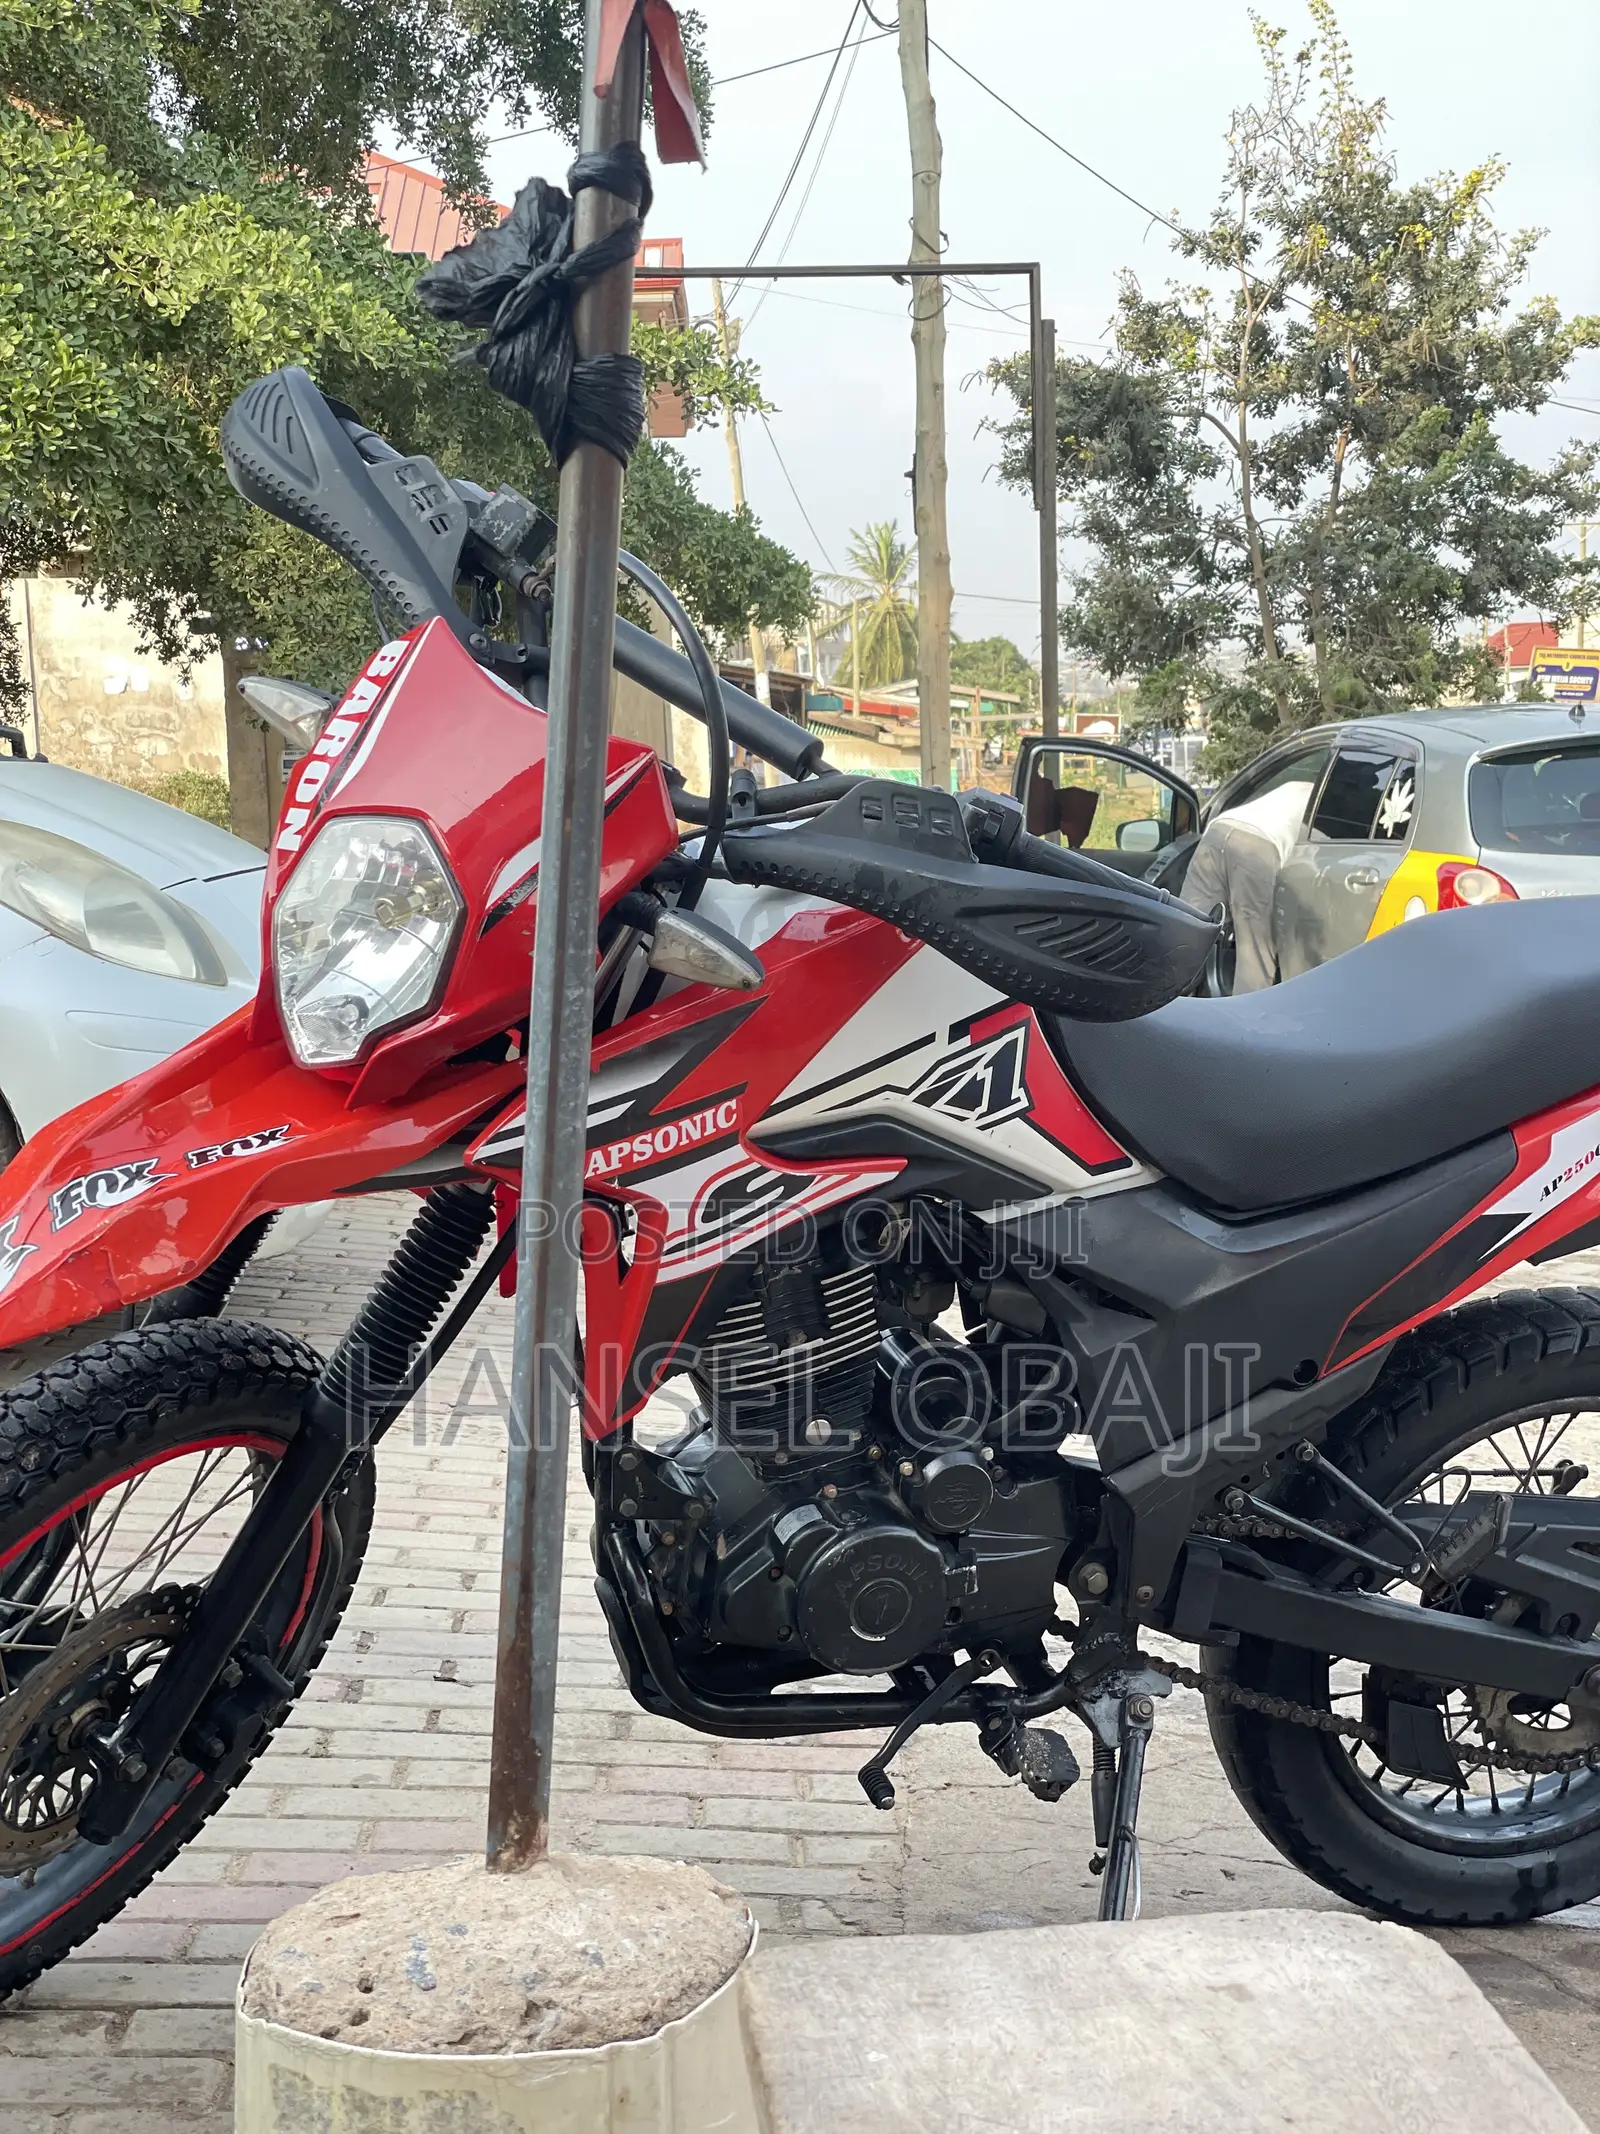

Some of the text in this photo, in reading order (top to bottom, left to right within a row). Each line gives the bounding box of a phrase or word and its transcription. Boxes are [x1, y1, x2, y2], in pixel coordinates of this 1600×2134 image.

[276, 640, 410, 851] BARON
[188, 1125, 302, 1169] FOX
[584, 1099, 738, 1180] APSONIC
[51, 1157, 175, 1233] FOX
